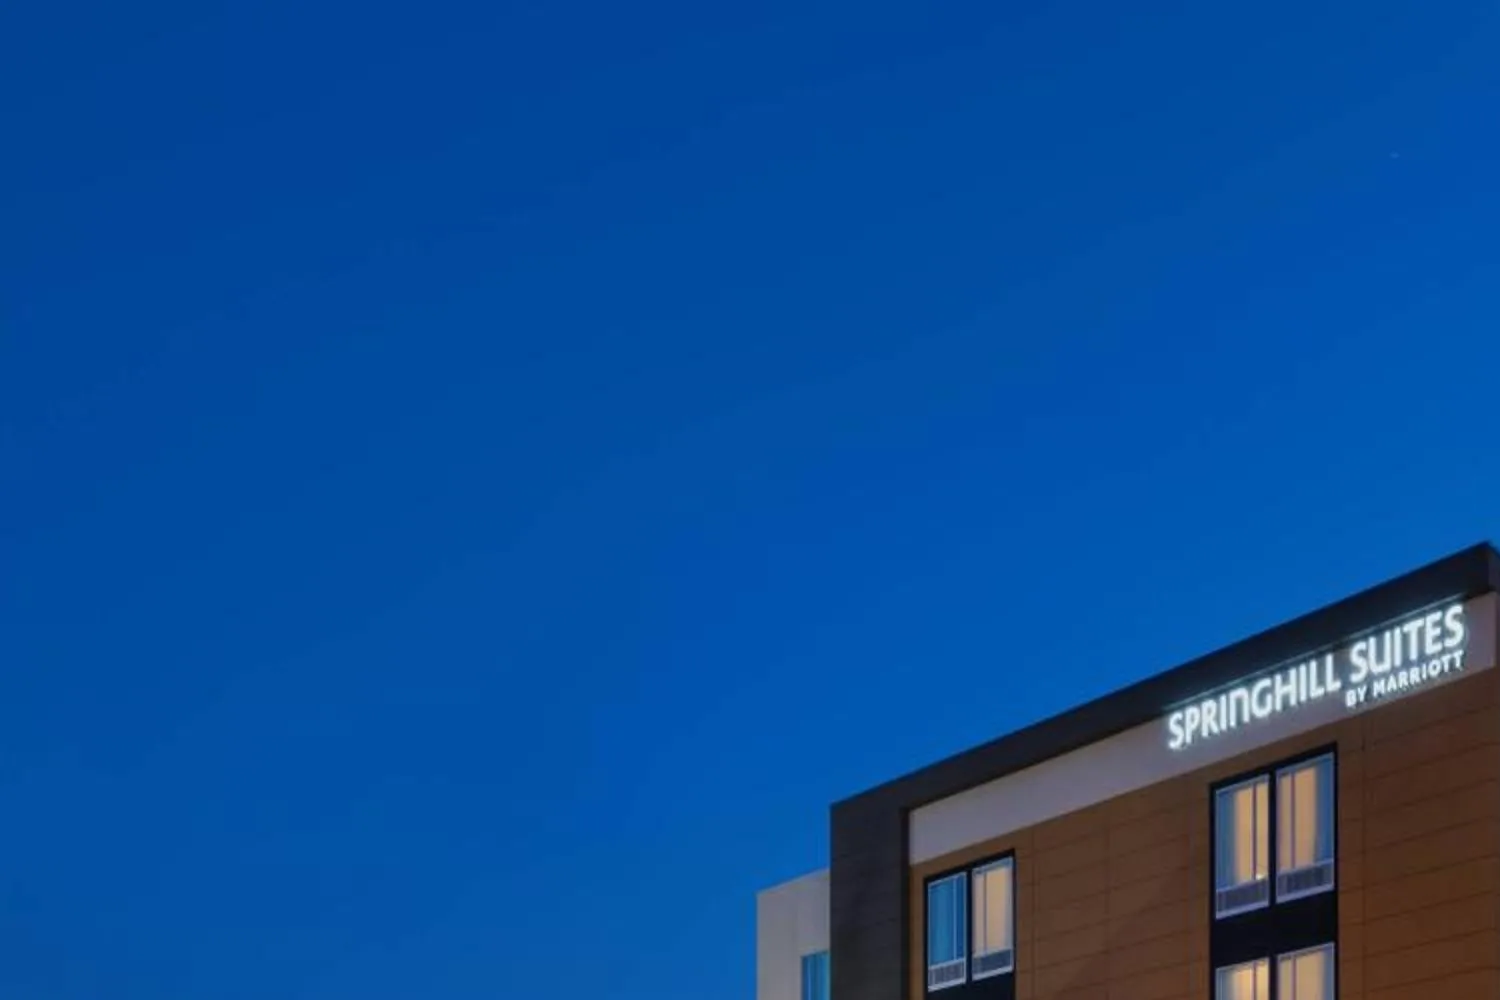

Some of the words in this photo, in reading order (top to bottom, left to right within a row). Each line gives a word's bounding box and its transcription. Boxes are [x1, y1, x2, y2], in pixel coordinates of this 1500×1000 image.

[1168, 653, 1342, 749] SPRINGHILL
[1350, 604, 1464, 683] SUITES
[1345, 685, 1366, 708] BY
[1373, 650, 1464, 698] MARRIOTT
